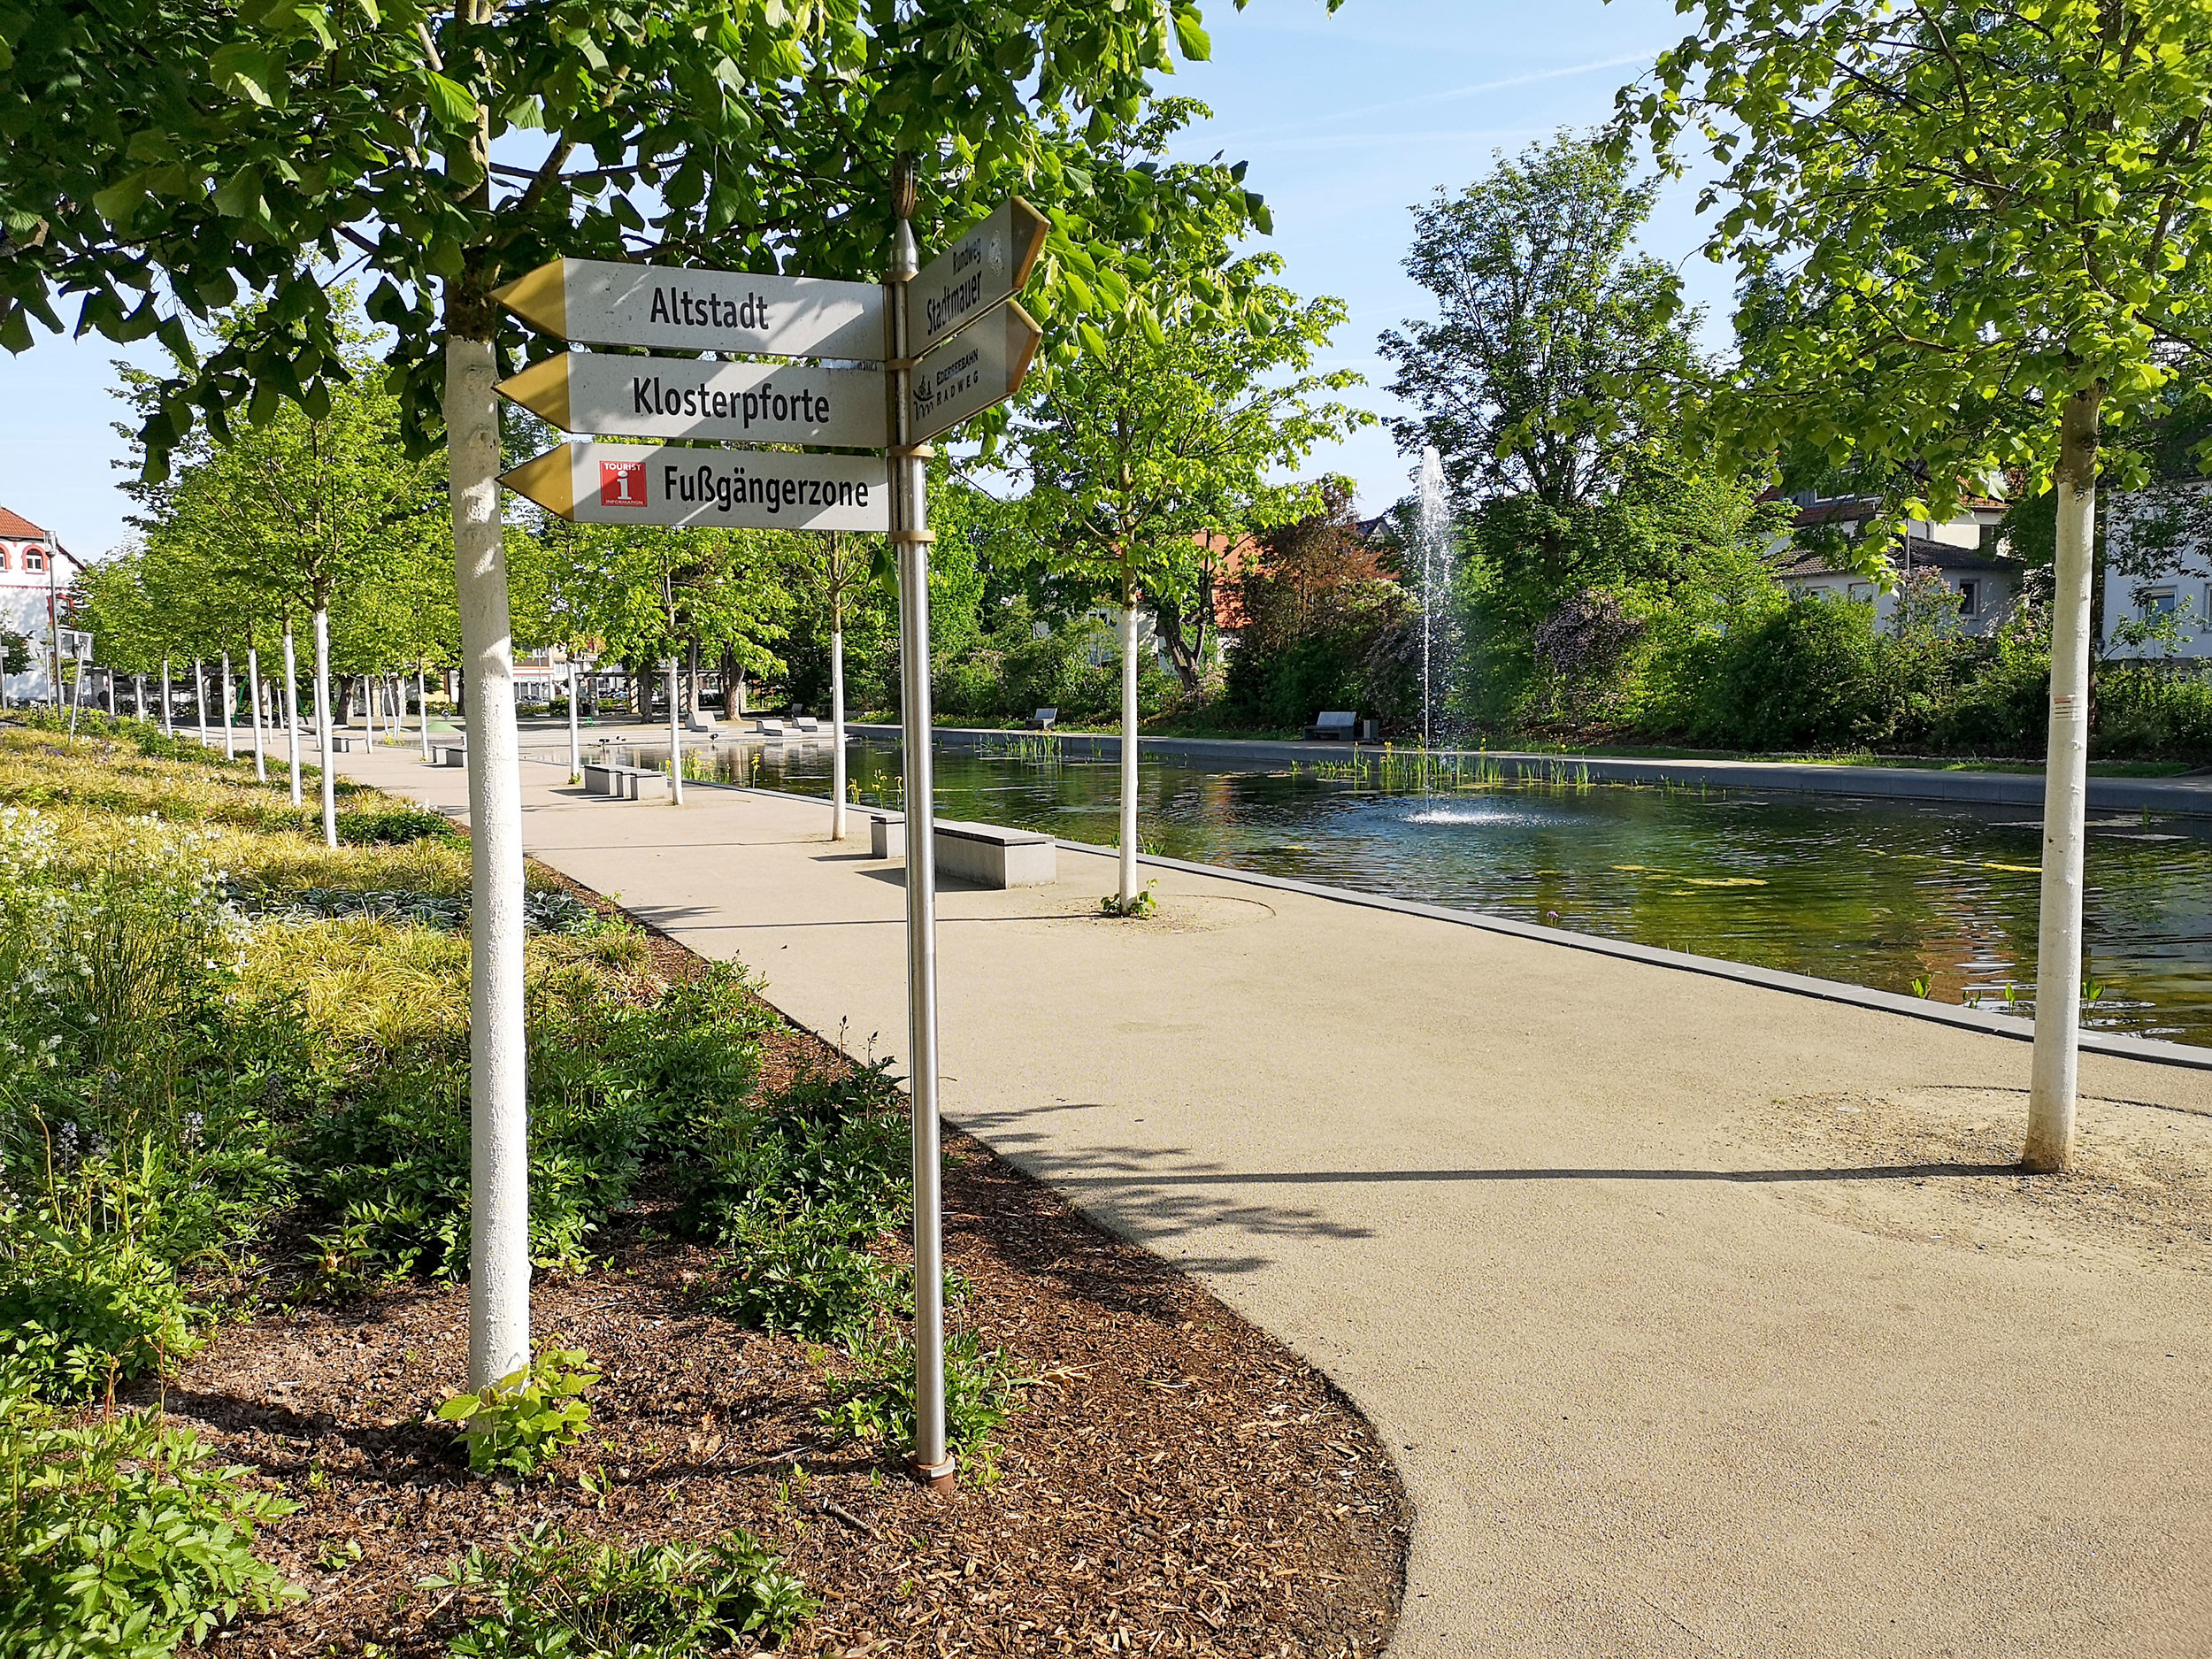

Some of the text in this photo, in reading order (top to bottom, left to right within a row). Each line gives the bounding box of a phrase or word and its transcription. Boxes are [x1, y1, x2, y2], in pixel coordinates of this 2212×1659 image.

[953, 238, 981, 275] Rundweg
[650, 287, 769, 330] Altstadt
[926, 270, 982, 336] Stadtmauer
[634, 377, 830, 428] Klosterpforte
[936, 370, 979, 406] RADWEG
[664, 465, 869, 514] Fußgängerzone
